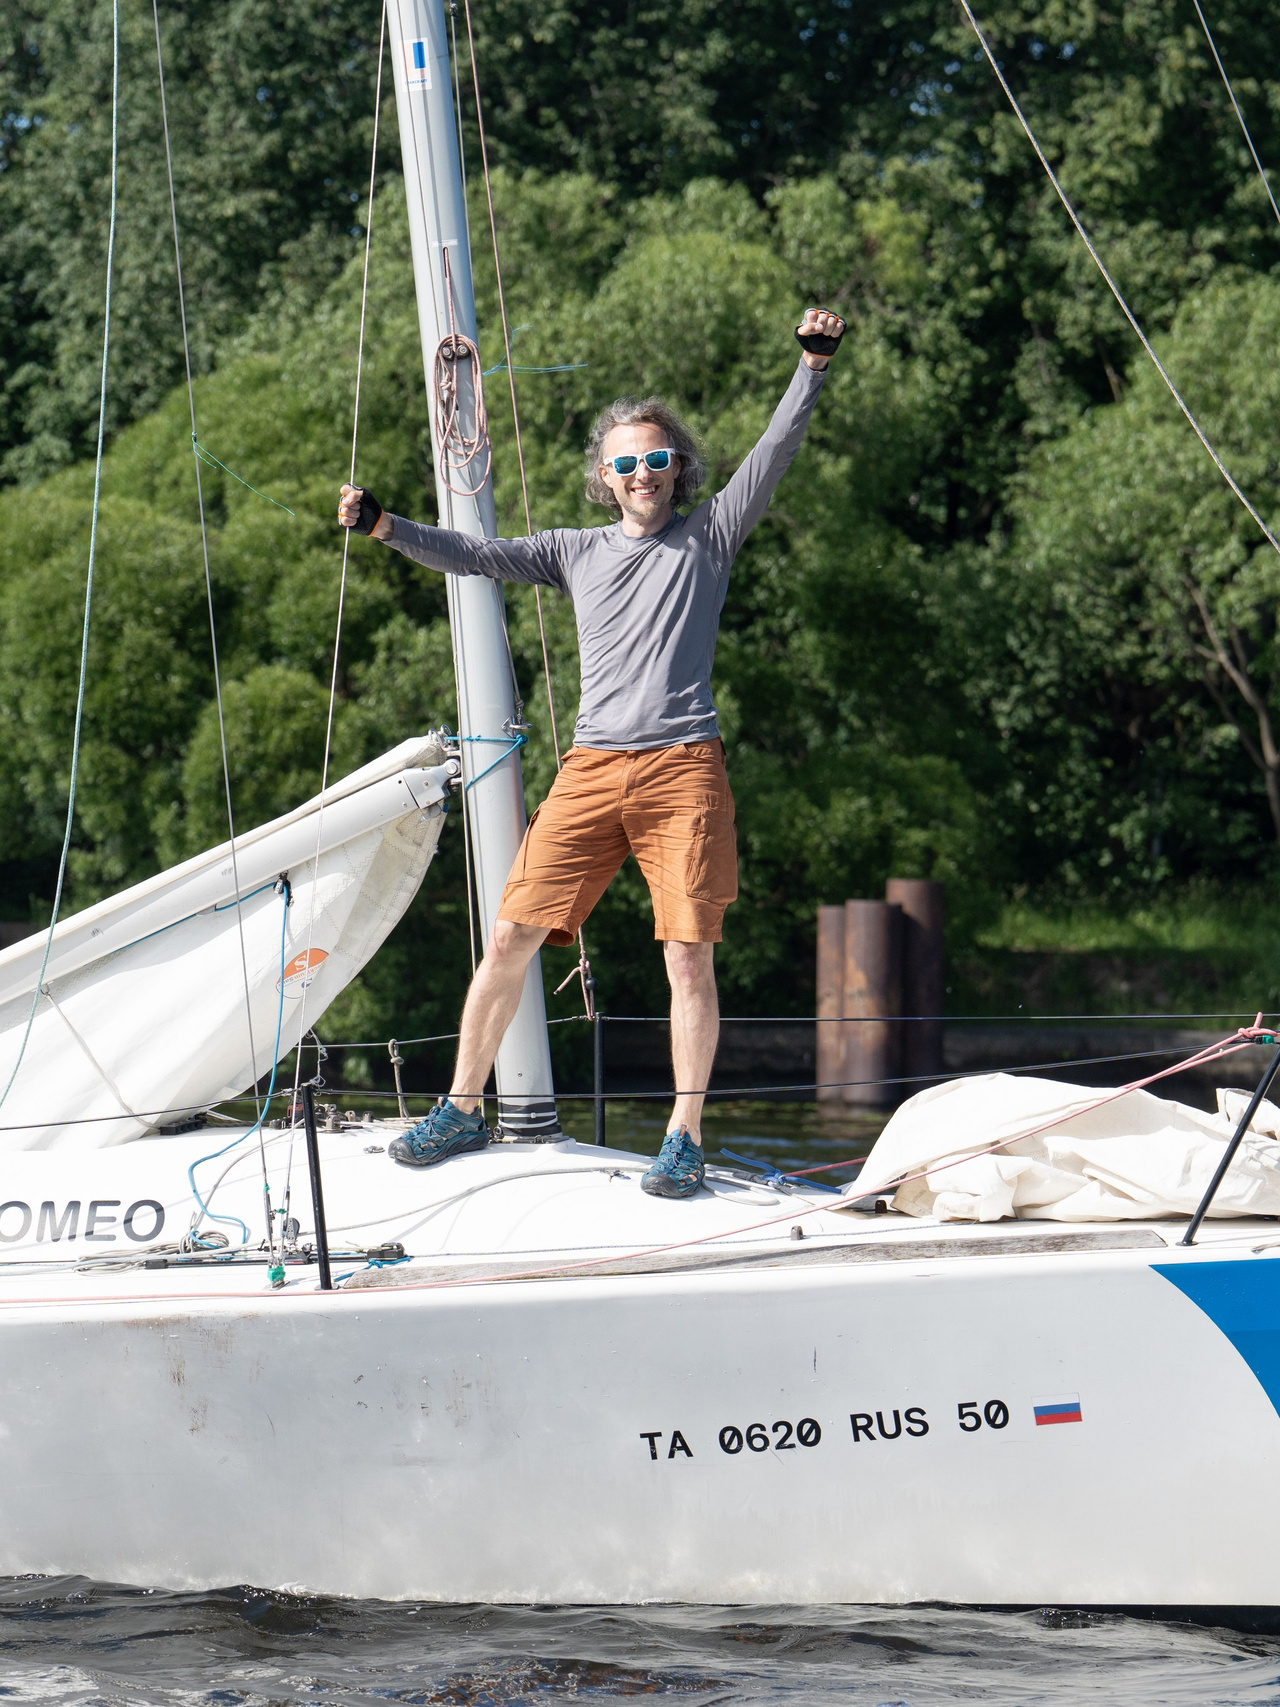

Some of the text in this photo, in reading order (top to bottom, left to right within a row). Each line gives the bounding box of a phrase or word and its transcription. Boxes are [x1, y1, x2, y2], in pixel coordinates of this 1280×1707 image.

[639, 1399, 1010, 1461] TA 0620 RUS 50
